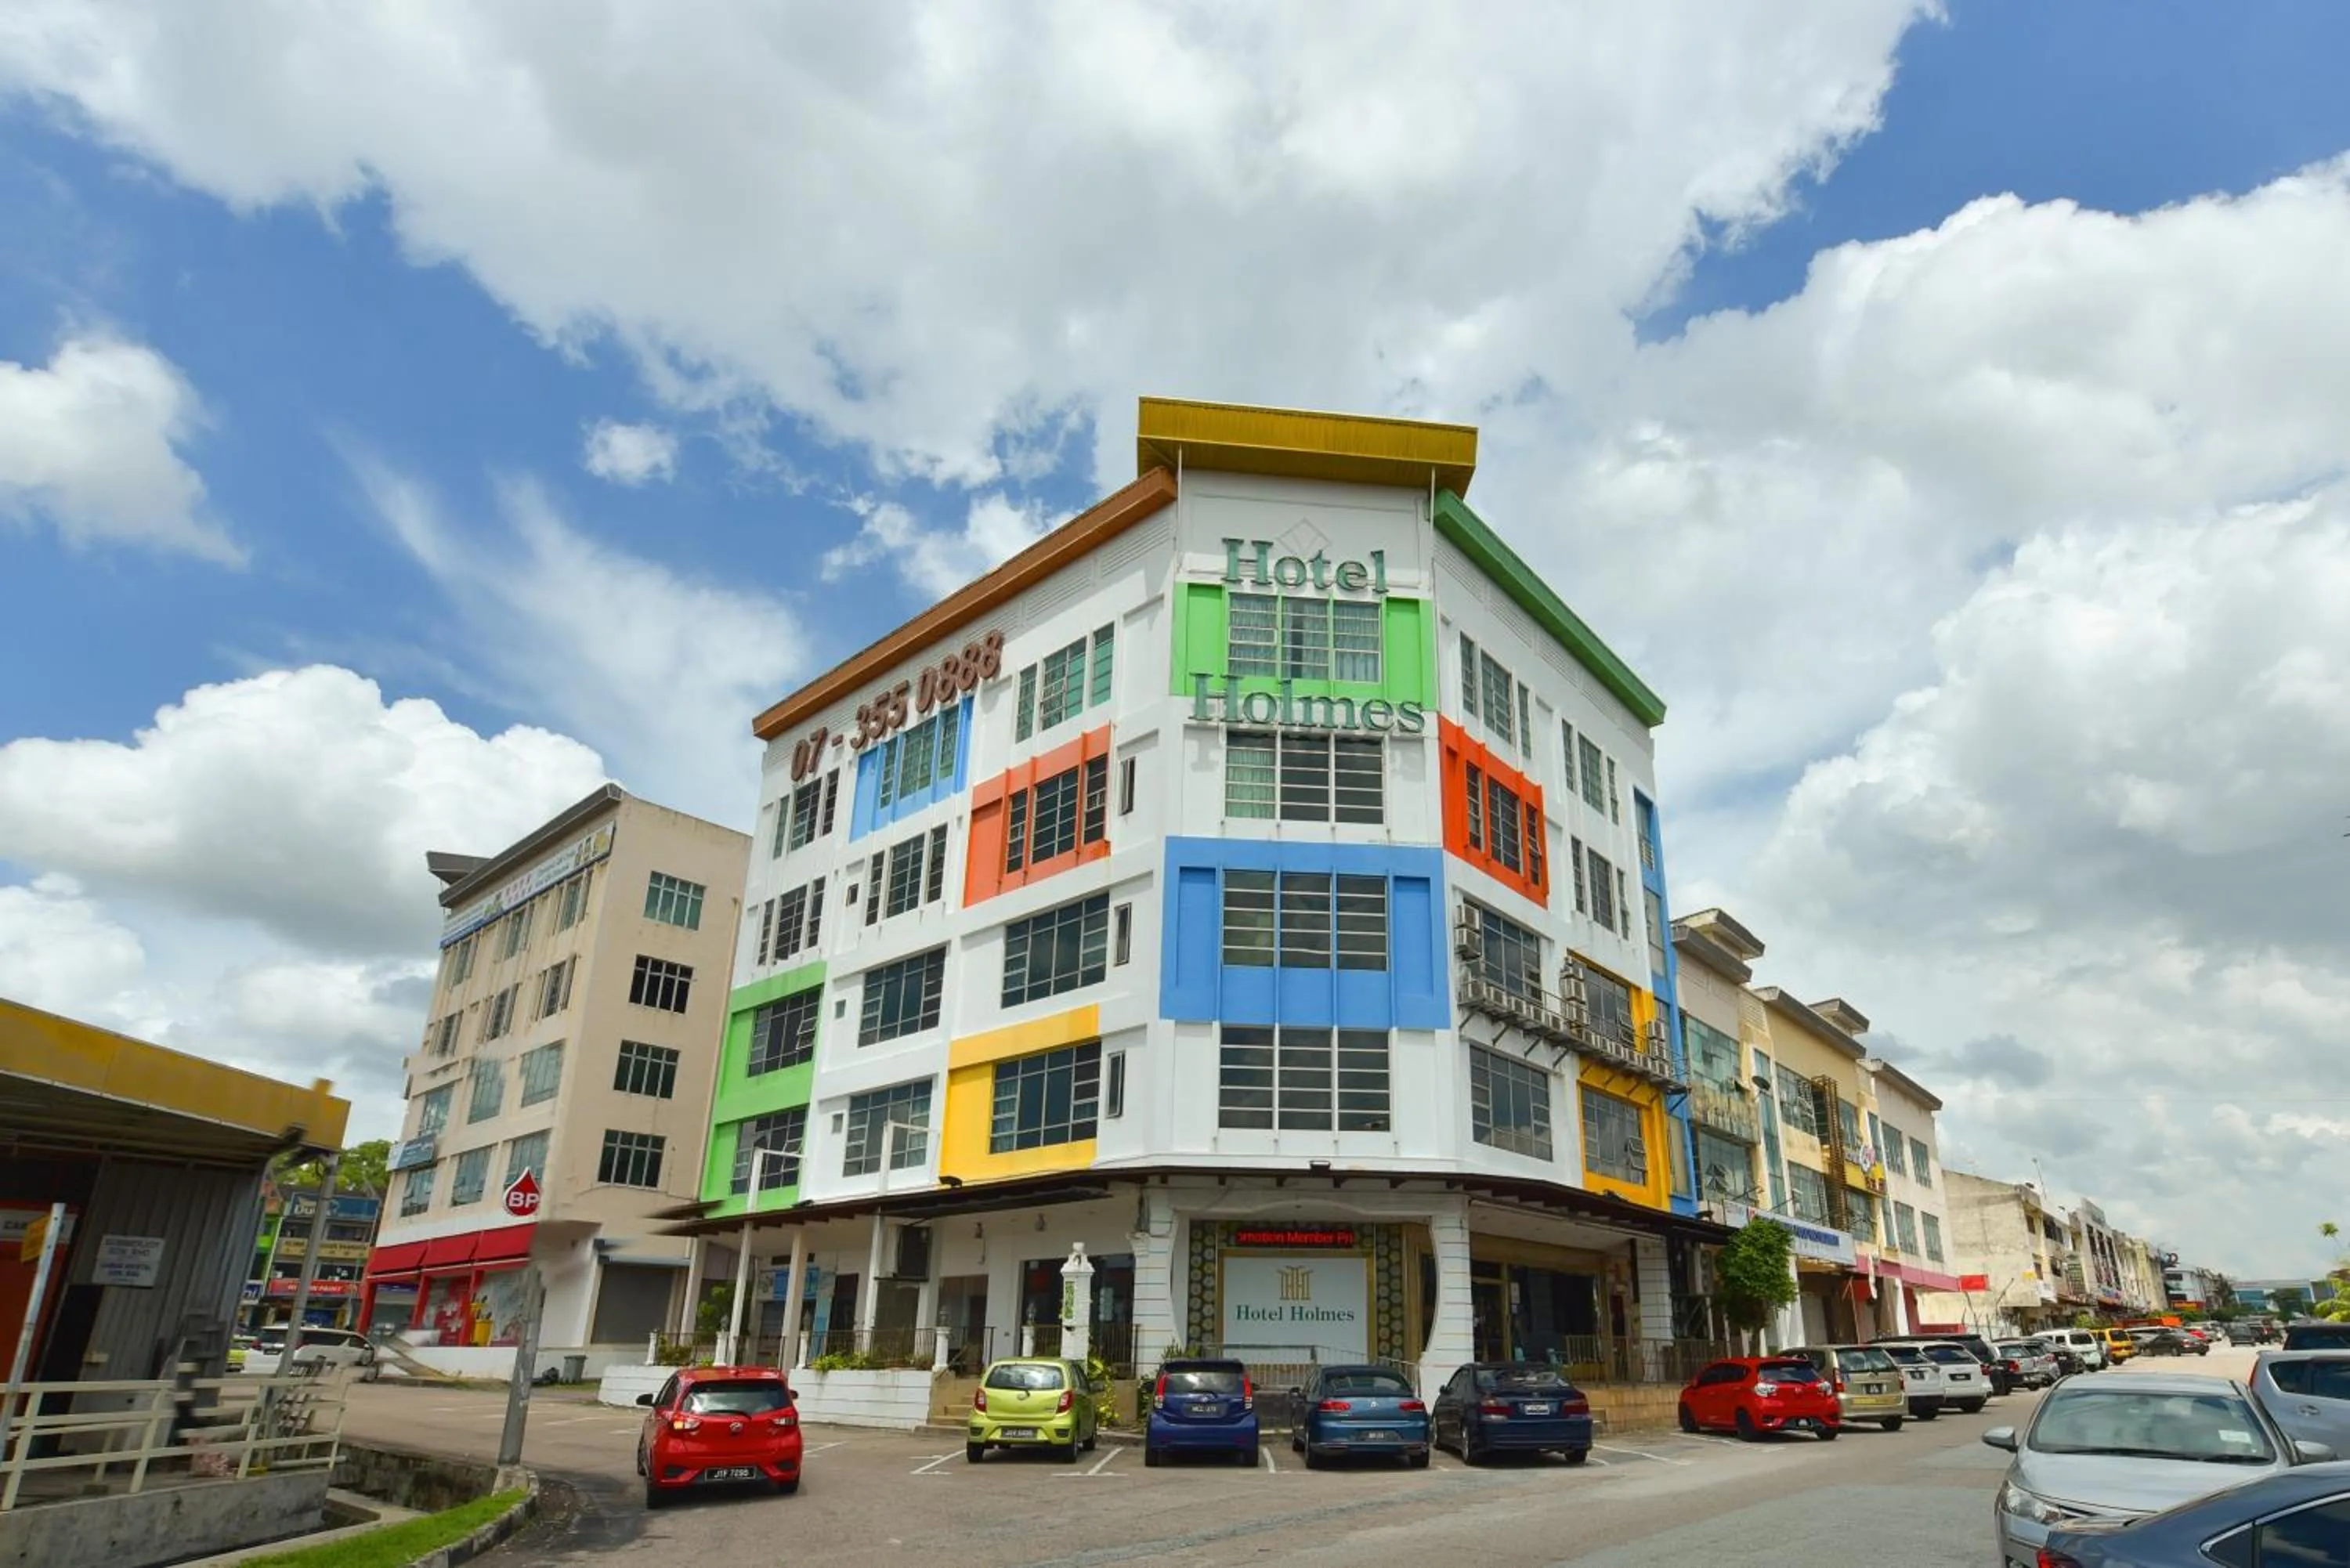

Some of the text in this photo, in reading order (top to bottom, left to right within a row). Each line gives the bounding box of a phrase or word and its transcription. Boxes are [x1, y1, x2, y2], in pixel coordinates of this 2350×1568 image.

[1221, 537, 1390, 594] Hotel
[916, 629, 1004, 714] 0888
[1188, 671, 1426, 733] Holmes
[509, 1191, 540, 1208] BP
[1287, 1230, 1334, 1244] Member
[1236, 1305, 1354, 1321] Hotel Holmes
